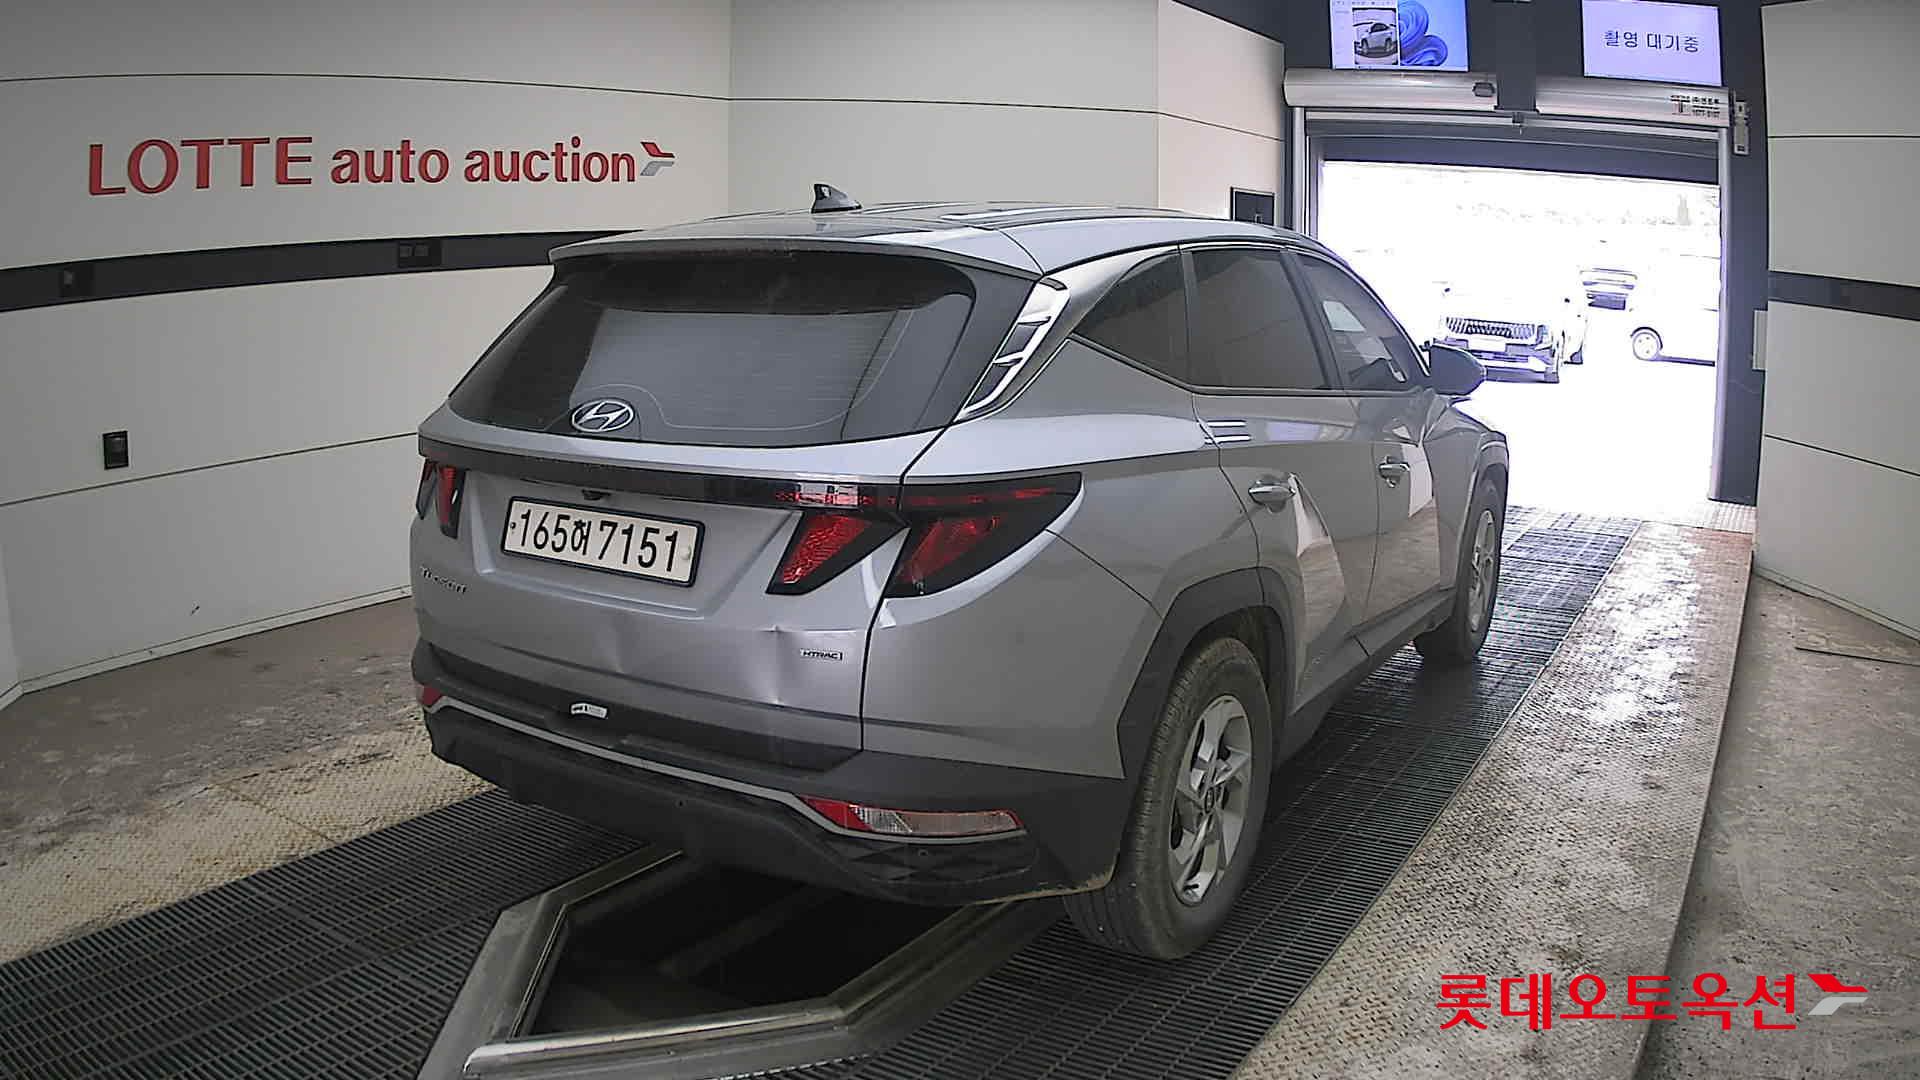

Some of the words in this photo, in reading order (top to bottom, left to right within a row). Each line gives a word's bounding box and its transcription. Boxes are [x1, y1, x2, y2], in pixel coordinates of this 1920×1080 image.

[1646, 33, 1699, 53] 대기중
[89, 137, 312, 195] LOTTE
[331, 139, 450, 184] auto
[464, 135, 635, 183] auction
[598, 520, 678, 572] 7151
